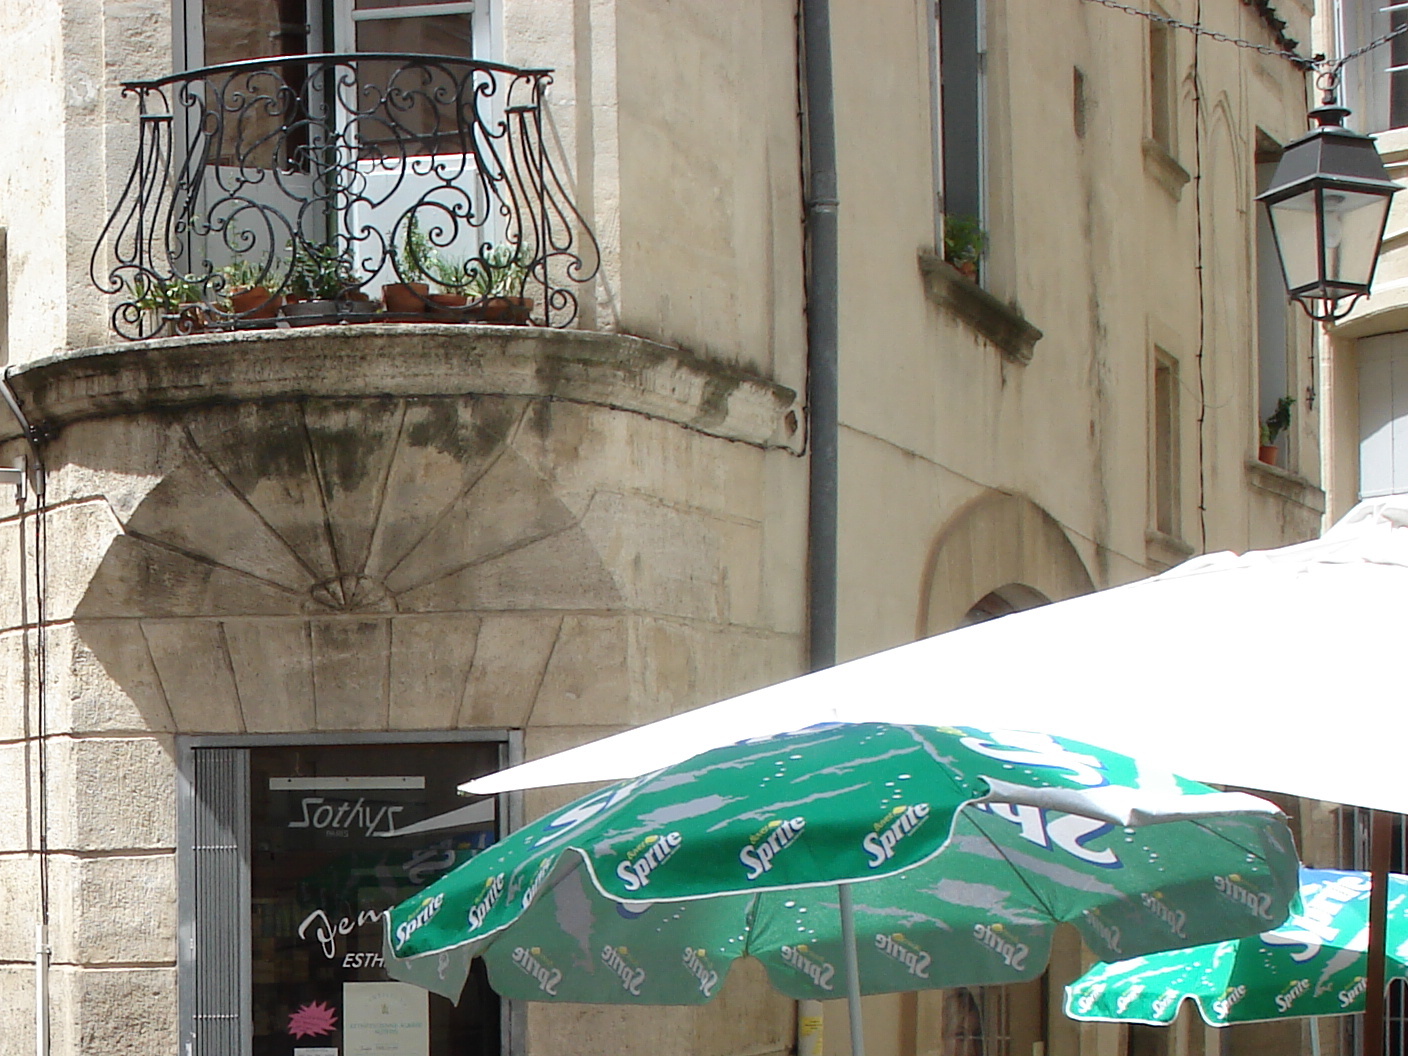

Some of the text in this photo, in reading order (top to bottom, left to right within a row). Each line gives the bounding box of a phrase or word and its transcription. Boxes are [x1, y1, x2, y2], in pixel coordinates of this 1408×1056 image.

[287, 797, 404, 837] Sothys
[862, 803, 931, 869] Sprite
[616, 831, 683, 892] Sprite
[738, 816, 808, 881] Sprite
[395, 893, 445, 951] Sprite
[468, 872, 506, 933] Sprite
[298, 908, 384, 959] Jen
[342, 952, 386, 968] ESTH
[1212, 984, 1246, 1020] Sprite
[1274, 978, 1311, 1013] Sprite
[1338, 976, 1367, 1008] Sprit
